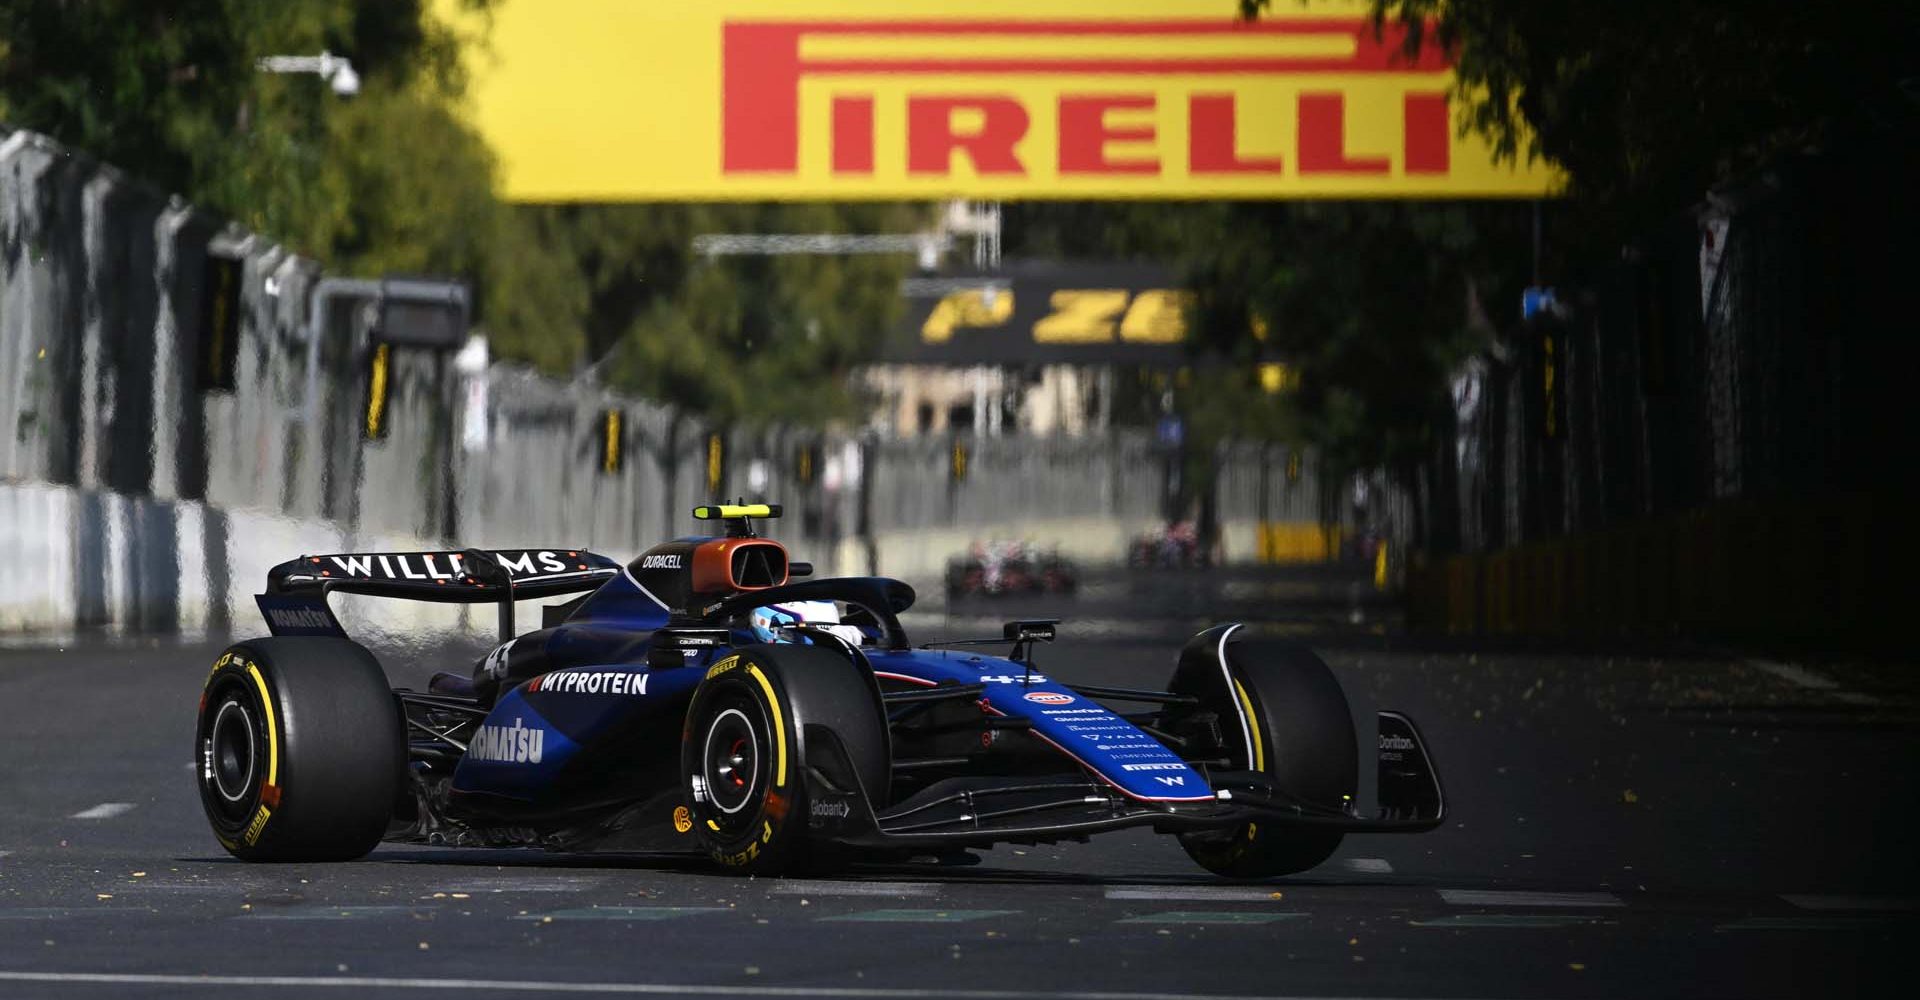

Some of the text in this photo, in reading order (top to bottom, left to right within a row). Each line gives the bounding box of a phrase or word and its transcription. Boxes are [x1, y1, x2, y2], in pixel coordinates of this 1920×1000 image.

[722, 20, 1452, 175] PIRELLI
[921, 287, 1015, 345] P
[330, 551, 566, 579] WILLIMS
[642, 555, 681, 568] DURACELL
[484, 639, 518, 681] 43
[706, 655, 740, 680] PIRELLI
[540, 672, 649, 695] MYPROTEIN
[980, 675, 1048, 684] 43
[1121, 762, 1188, 772] PIRELLI
[810, 799, 843, 817] Globant
[245, 804, 271, 846] PIRELLI
[762, 819, 772, 844] P
